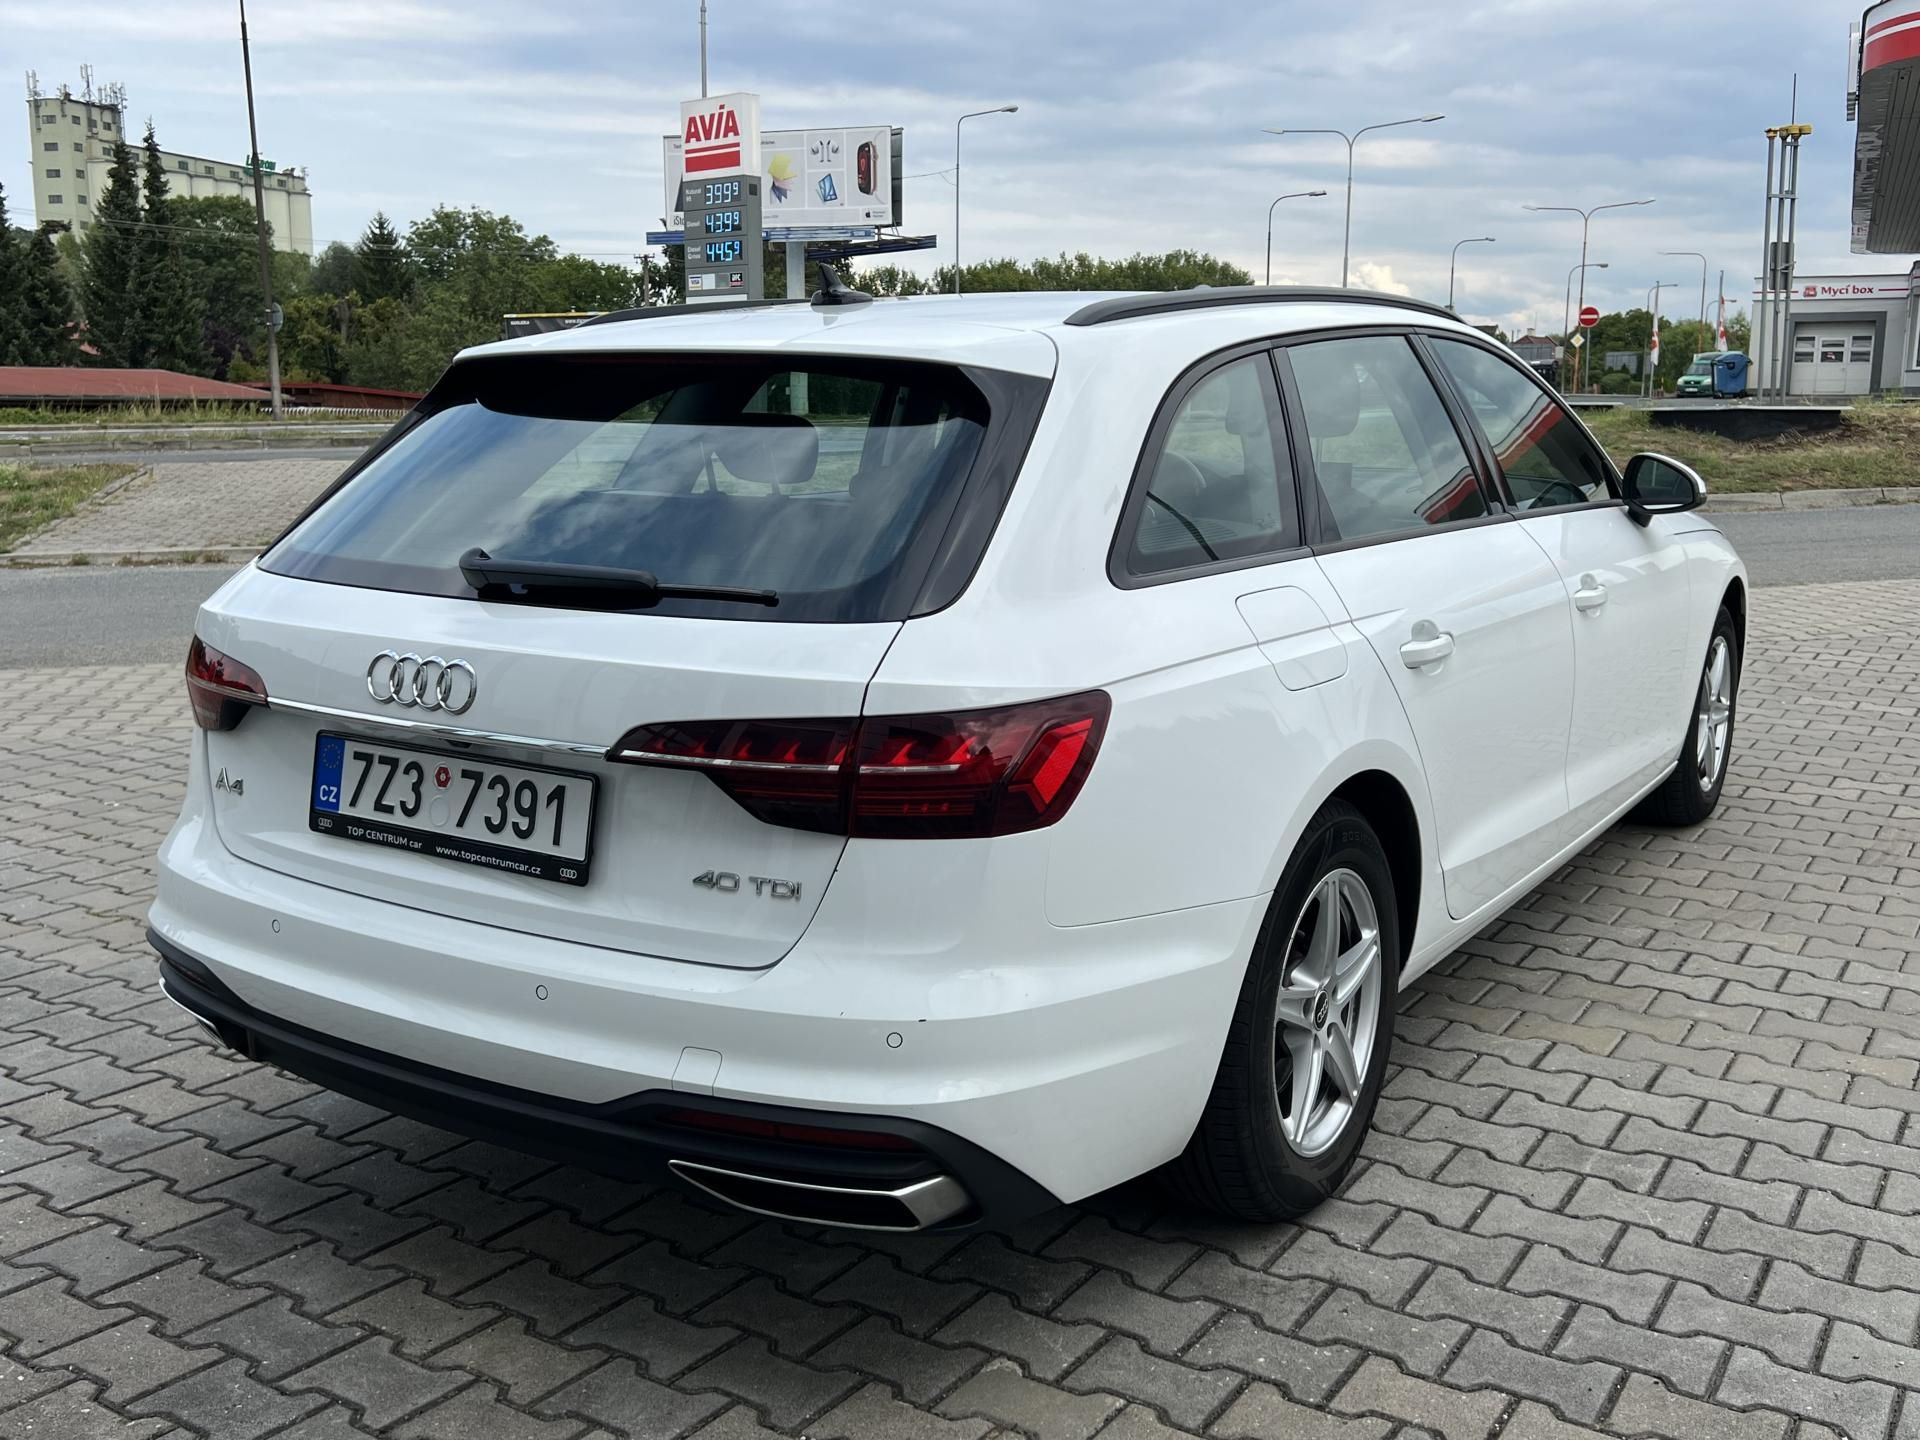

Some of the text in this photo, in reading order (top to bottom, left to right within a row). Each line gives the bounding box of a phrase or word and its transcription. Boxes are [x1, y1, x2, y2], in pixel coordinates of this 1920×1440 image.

[1821, 285, 1874, 297] Mycí box
[215, 767, 244, 797] A4
[319, 784, 338, 803] CZ
[348, 750, 567, 846] 7Z3 7391
[347, 825, 422, 850] TOP CENTRUM car
[435, 845, 542, 875] www.topcentrumcar.cz
[692, 870, 802, 902] 40 TDI
